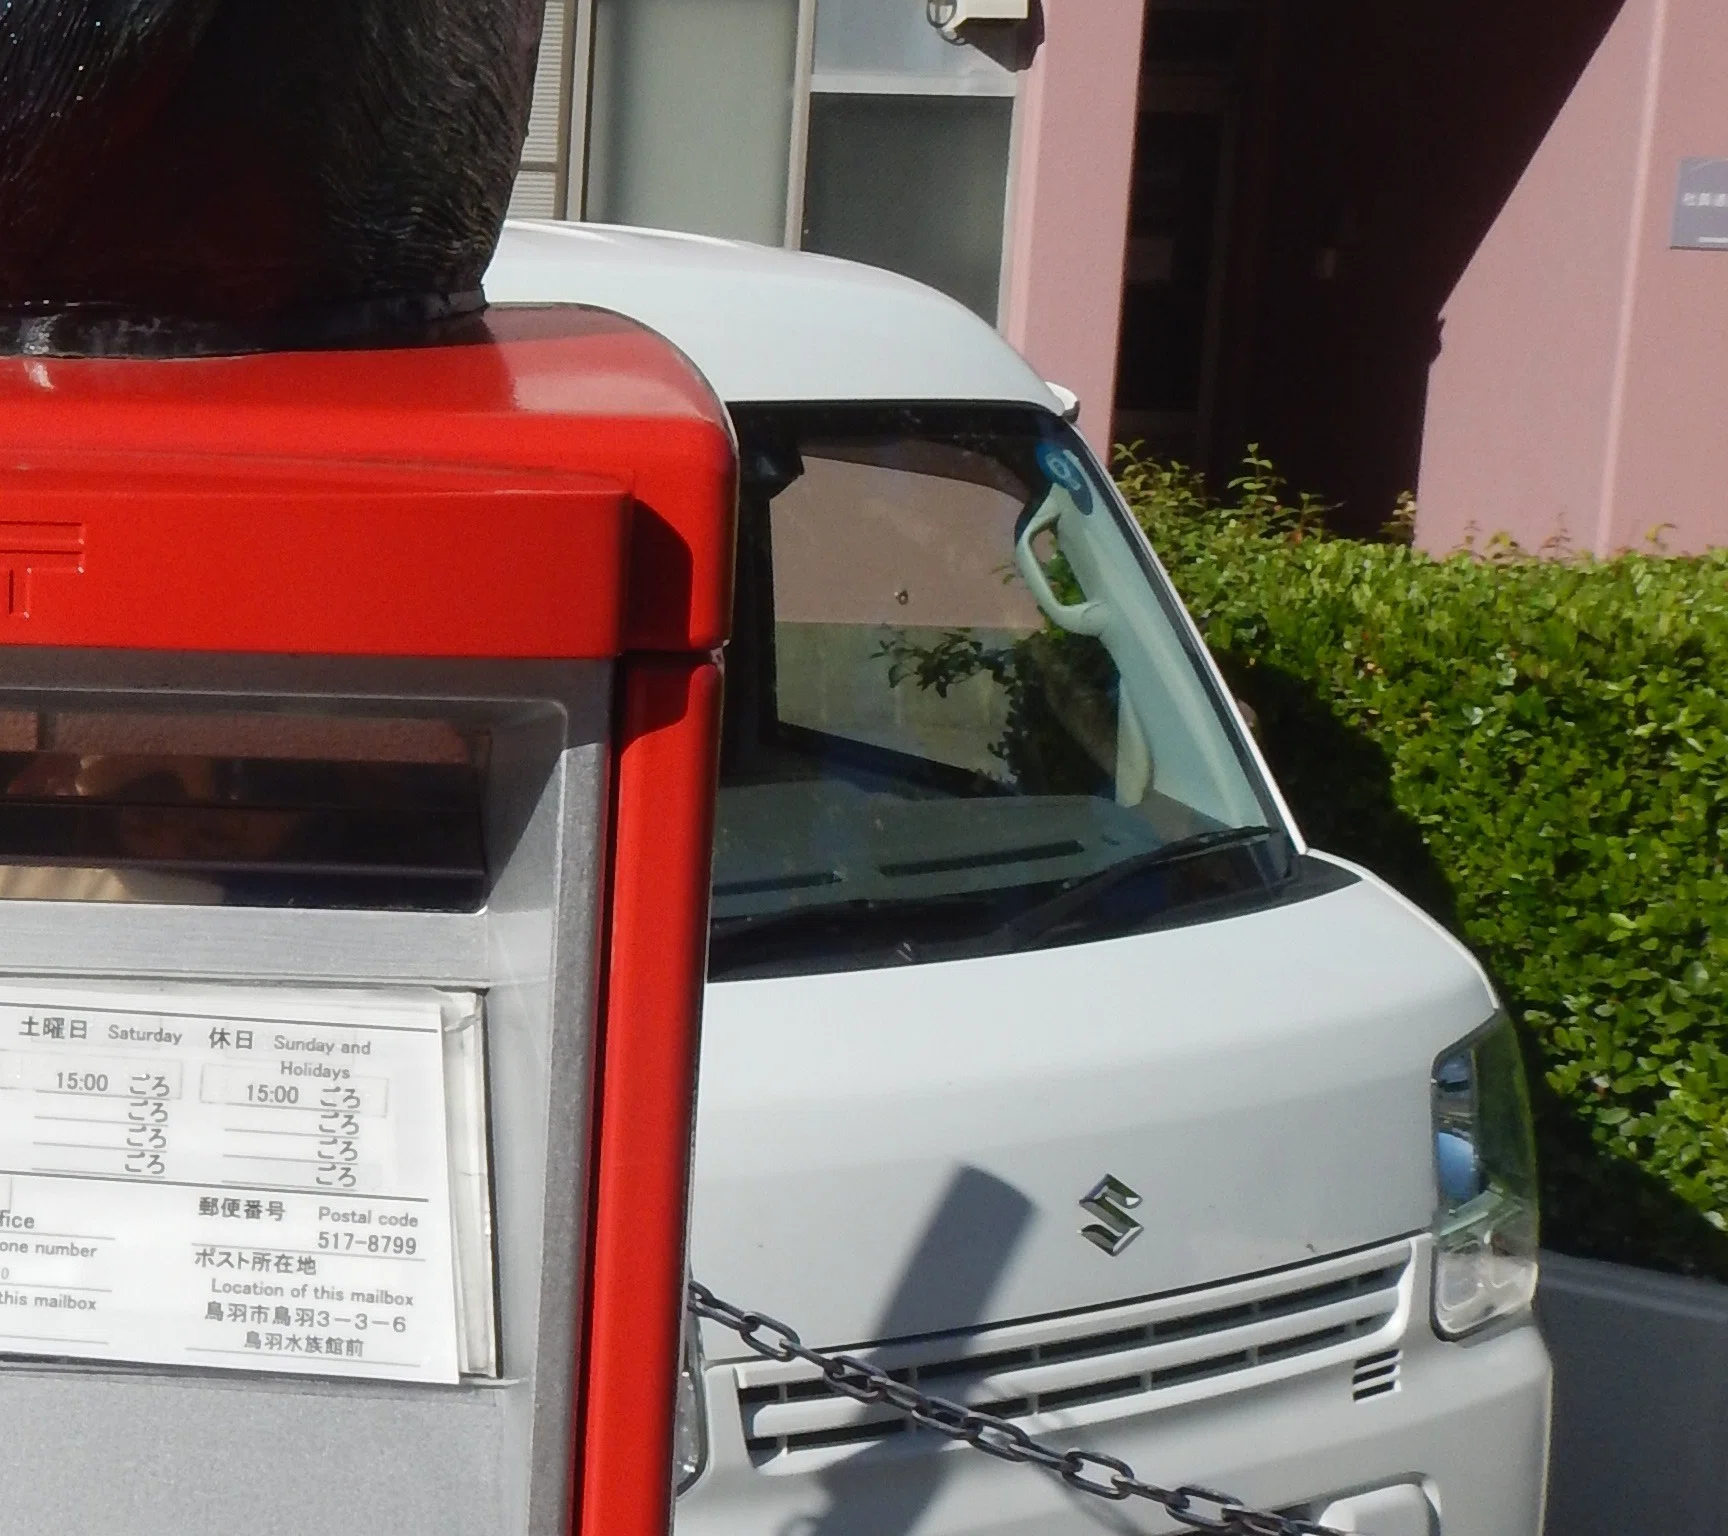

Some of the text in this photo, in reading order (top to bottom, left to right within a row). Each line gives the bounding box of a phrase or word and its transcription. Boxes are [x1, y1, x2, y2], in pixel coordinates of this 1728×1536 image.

[19, 1016, 183, 1046] 土曜日 Saturday
[209, 1026, 371, 1056] 休日 Sunday and
[280, 1060, 351, 1081] Holidays
[57, 1071, 109, 1092] 15:00
[129, 1073, 170, 1098] ごろ
[247, 1084, 300, 1105] 15:00
[320, 1086, 361, 1110] ごろ
[128, 1100, 168, 1124] ごろ
[318, 1112, 359, 1136] ごろ
[126, 1125, 167, 1149] ごろ
[317, 1138, 358, 1162] ごろ
[124, 1152, 165, 1175] ごろ
[315, 1164, 356, 1188] ごろ
[199, 1196, 418, 1227] 郵便番号 Postal code
[35, 1241, 98, 1259] number
[317, 1231, 417, 1255] 517-8799
[195, 1248, 317, 1276] ポスト所在地
[34, 1291, 97, 1311] mailbox
[211, 1278, 414, 1306] Location of this mailbox
[244, 1331, 364, 1357] 鳥羽水族館前
